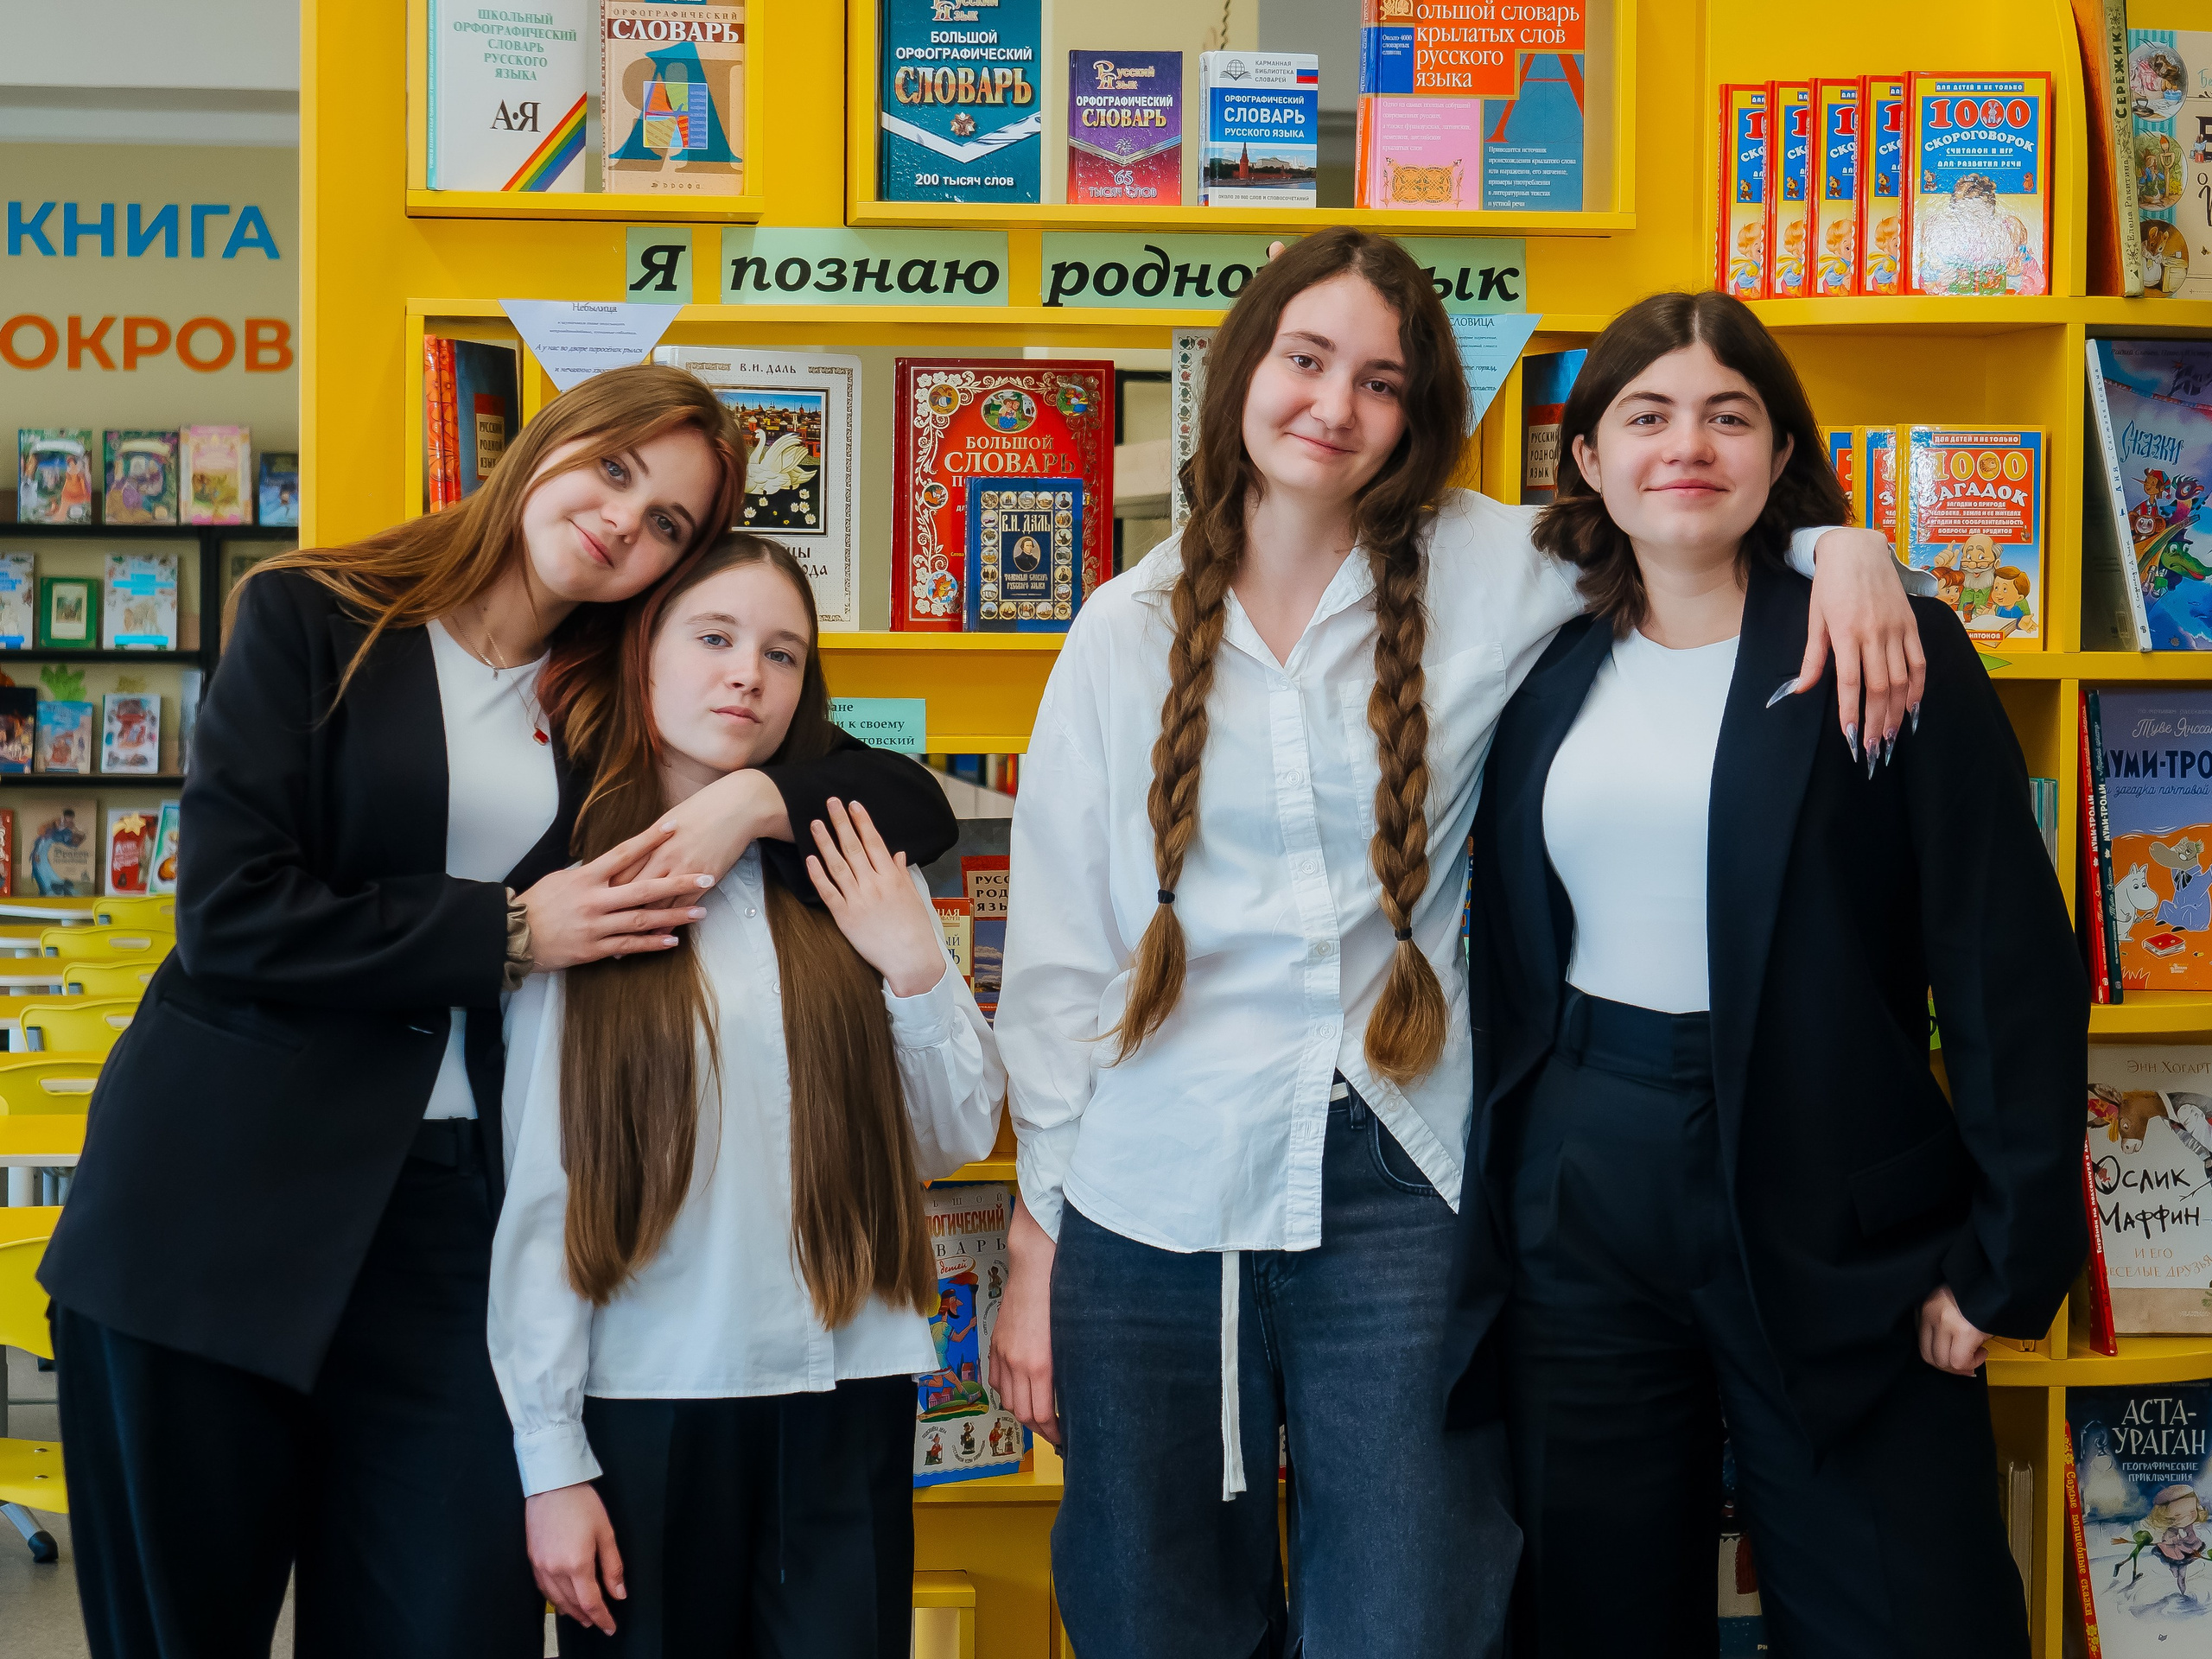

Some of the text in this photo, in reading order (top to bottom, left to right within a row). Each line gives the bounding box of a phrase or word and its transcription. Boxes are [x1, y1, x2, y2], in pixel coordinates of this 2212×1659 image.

[478, 9, 553, 26] ШКОЛЬНЫЙ
[613, 9, 738, 21] ОРФОГРАФИЧЕСКИЙ
[1500, 4, 1580, 27] словарь
[454, 21, 577, 42] ОРФОГРАФИЧЕСКИЙ
[612, 19, 739, 42] СЛОВАРЬ
[931, 29, 997, 43] БОЛЬШОЙ
[1417, 27, 1566, 48] крылатых слов
[488, 39, 544, 53] СЛОВАРЬ
[895, 46, 1033, 60] ОРФОГРАФИЧЕСКИЙ
[484, 52, 548, 68] РУССКОГО
[1417, 49, 1504, 70] русского
[495, 67, 537, 81] ЯЗЫКА
[1416, 72, 1472, 88] языка
[894, 66, 1032, 105] СЛОВАРЬ
[1077, 94, 1173, 107] ОРФОГРАФИЧЕСКИЙ
[1224, 95, 1304, 104] ОРФОГРАФИЧЕСКИЙ
[1082, 108, 1166, 127] СЛОВАРЬ
[1224, 107, 1306, 124] СЛОВАРЬ
[1929, 99, 2031, 129] 1000
[1224, 128, 1305, 138] РУССКОГО ЯЗЫКА
[1924, 130, 2035, 152] СКОРОГОВОРОК
[914, 174, 1014, 186] 200 тысяч слов
[1114, 169, 1134, 185] 65
[2123, 159, 2136, 242] Елена Ракитина
[7, 202, 281, 261] КНИГА
[628, 244, 1521, 308] Я познаю родно ык
[1450, 317, 1495, 328] СЛОВИЦА
[0, 314, 295, 374] ОКРОВ
[965, 435, 1055, 450] БОЛЬШОЙ
[2120, 419, 2185, 465] Сказки
[944, 451, 1076, 474] СЛОВАРЬ
[1928, 450, 2028, 481] 1000
[1529, 467, 1549, 479] ЯЗЫК
[860, 721, 905, 732] своему
[2132, 718, 2172, 738] Туве
[858, 735, 915, 745] товский
[925, 1204, 1005, 1237] ЛОГИЧЕСКИЙ
[937, 1238, 1006, 1256] ВАРЬ
[2108, 1266, 2160, 1278] ЕСЕЛЫЕ
[2121, 1398, 2196, 1425] АСТА-
[2112, 1427, 2206, 1455] УРАГАН
[2122, 1461, 2199, 1471] ГЕОГРАФИЧЕСКИЕ
[2128, 1472, 2193, 1482] ПРИКЛЮЧЕНИЯ
[2065, 1471, 2092, 1617] Самые волшебные сказки
